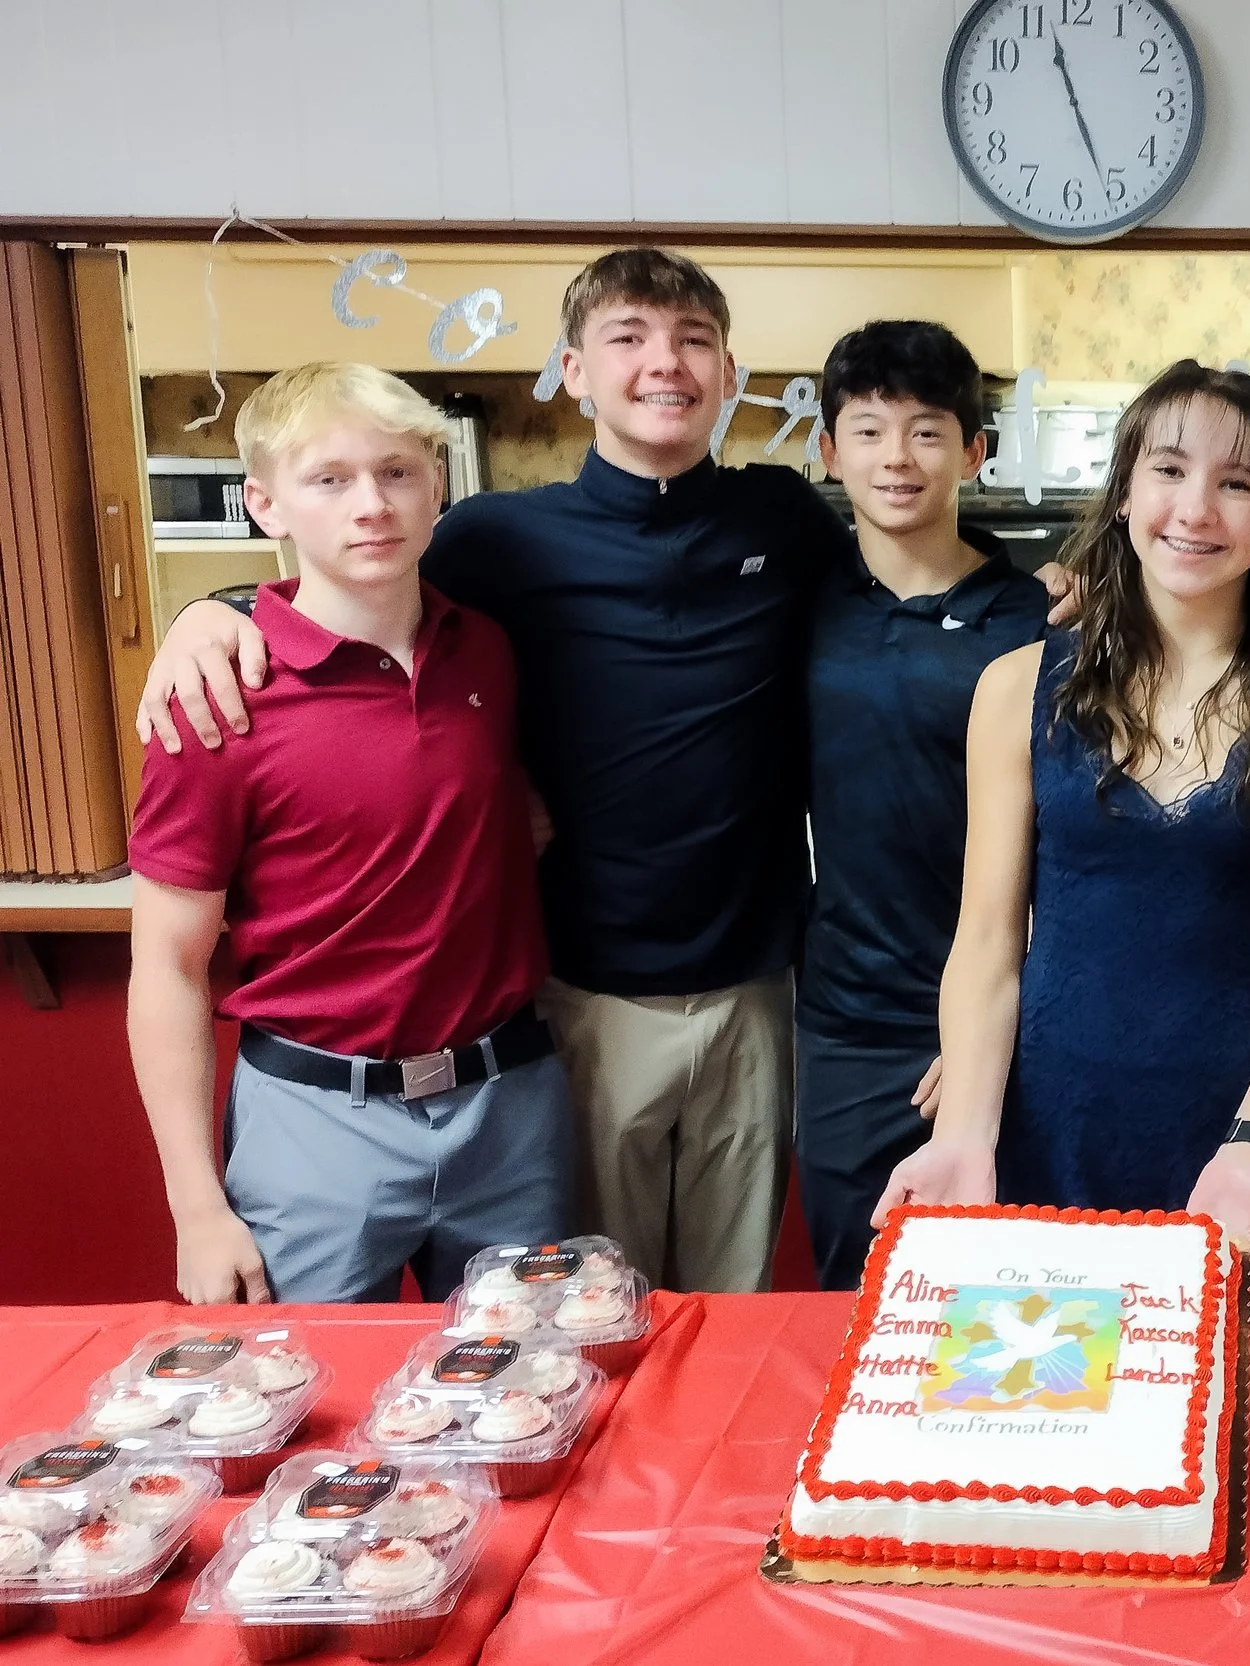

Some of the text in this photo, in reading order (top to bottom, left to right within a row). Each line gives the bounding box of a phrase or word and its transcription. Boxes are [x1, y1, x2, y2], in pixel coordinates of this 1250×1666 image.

[1018, 4, 1046, 39] 11
[1060, 0, 1093, 26] 12
[1112, 3, 1127, 39] 1
[988, 37, 1020, 73] 10
[1139, 38, 1161, 75] 2
[972, 81, 993, 116] 9
[1155, 87, 1176, 124] 3
[987, 130, 1007, 164] 8
[1137, 134, 1159, 168] 4
[1019, 164, 1040, 198] 7
[1063, 177, 1083, 212] 6
[1105, 167, 1126, 202] 5
[996, 1267, 1088, 1285] On Your
[1120, 1283, 1200, 1314] Jack
[874, 1313, 953, 1339] Emma
[1117, 1313, 1195, 1346] Karson
[857, 1353, 942, 1377] Hattie
[842, 1392, 920, 1417] Anna
[917, 1415, 1088, 1434] Confirmation
